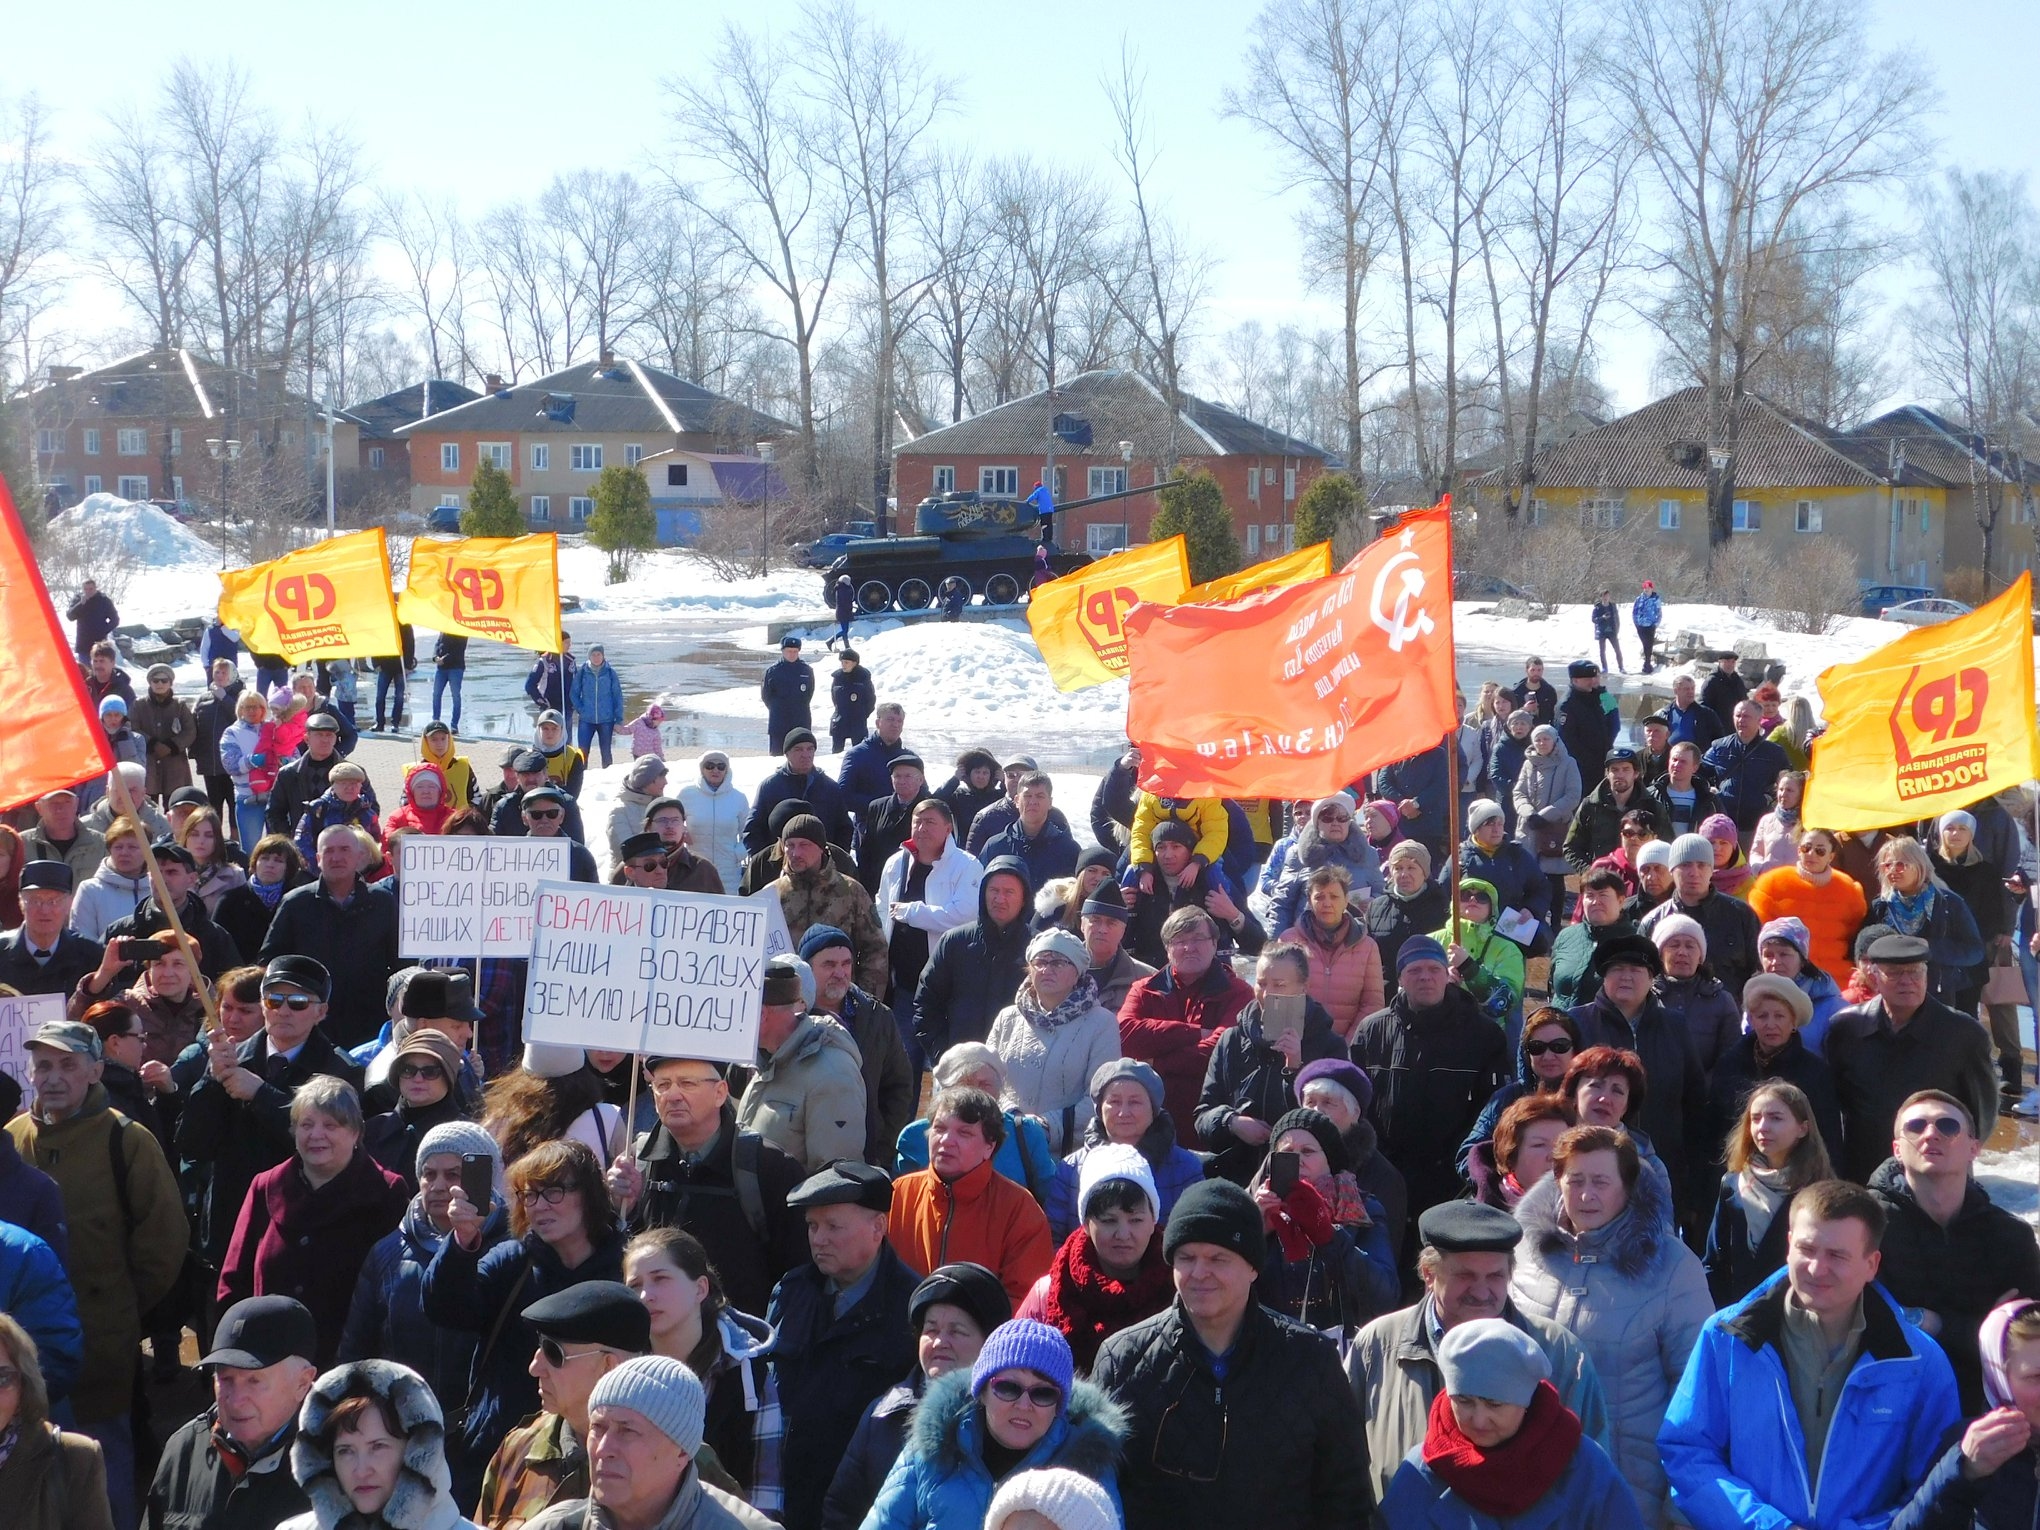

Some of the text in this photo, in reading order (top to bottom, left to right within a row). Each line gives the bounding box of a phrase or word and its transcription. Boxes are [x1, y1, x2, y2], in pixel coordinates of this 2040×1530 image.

[403, 845, 560, 873] ОТРАВЛЕННАЯ
[402, 881, 473, 908] СРЕДА
[402, 916, 473, 942] НАШИХ
[536, 894, 764, 948] СВАЛКИ ОТРАВЯТ
[531, 937, 612, 977] НАШИ
[528, 980, 623, 1022] ЗЕМЛЮ
[629, 990, 651, 1024] И
